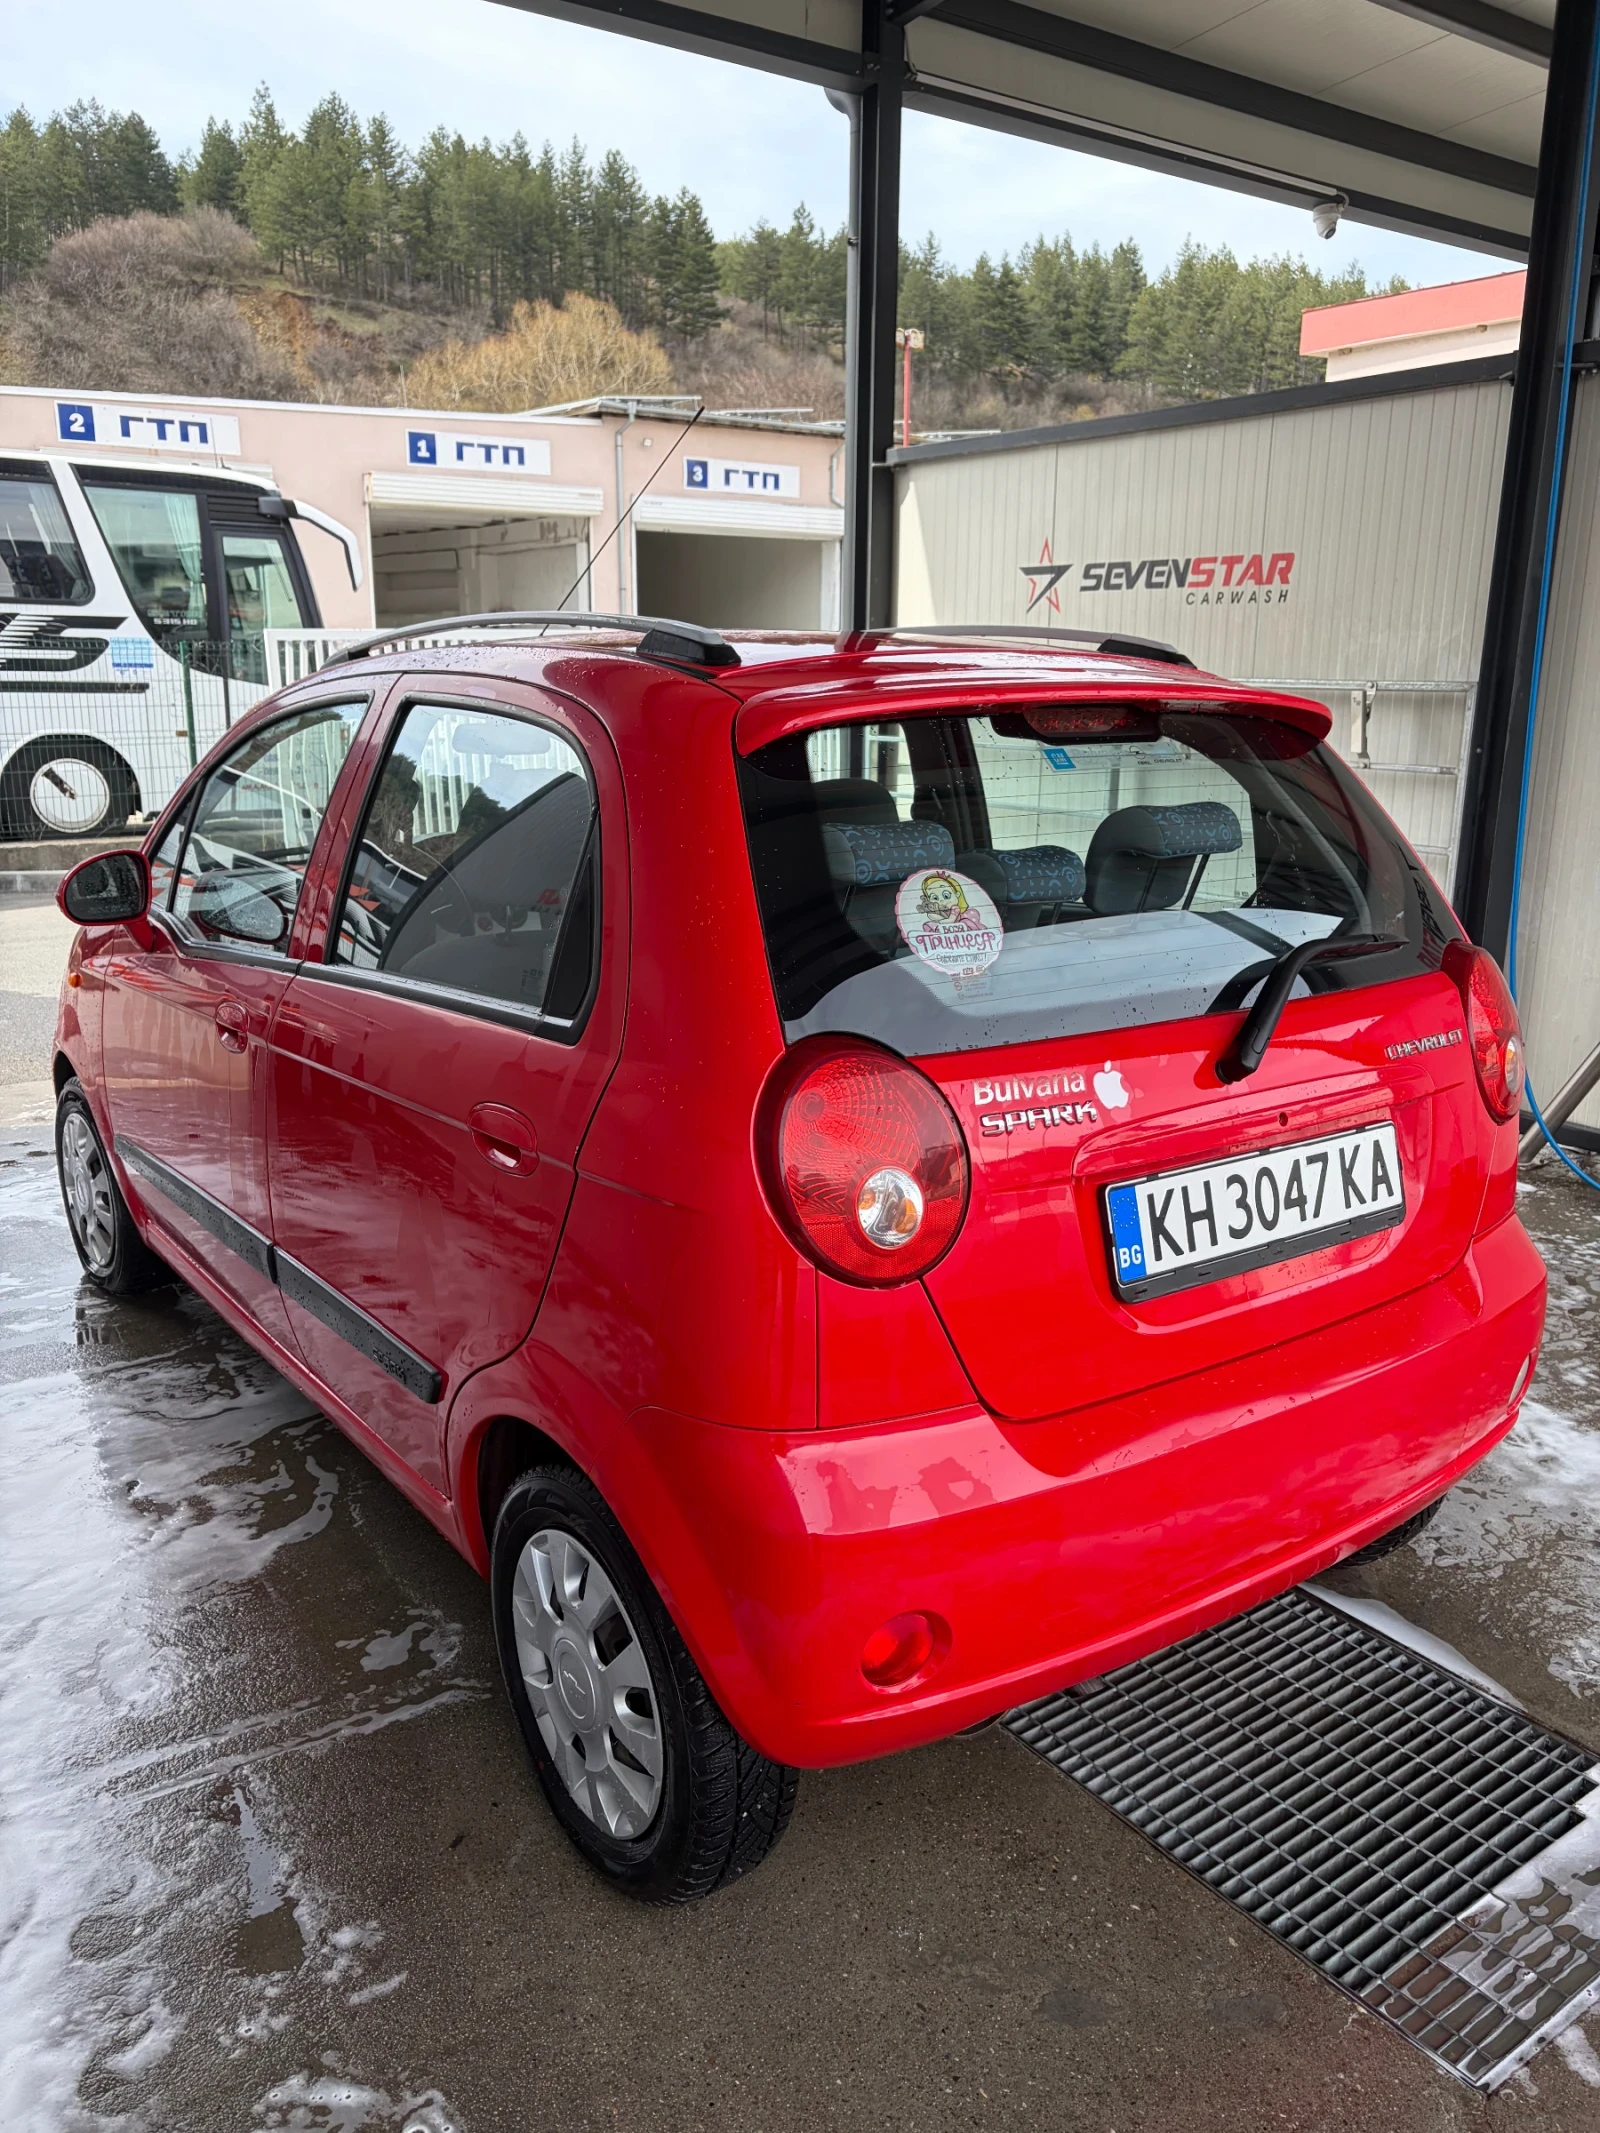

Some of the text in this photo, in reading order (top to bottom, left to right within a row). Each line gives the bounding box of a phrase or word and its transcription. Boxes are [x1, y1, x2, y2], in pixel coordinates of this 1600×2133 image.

[69, 412, 209, 444] 2 ГТП
[416, 440, 526, 466] 1 ГТП
[692, 464, 781, 491] 3 ГТП
[1186, 589, 1289, 606] CARWASH
[1384, 1028, 1463, 1060] CHEVROLET
[972, 1070, 1086, 1106] Bulvaria
[980, 1100, 1098, 1137] SPARK
[1119, 1245, 1143, 1269] BG
